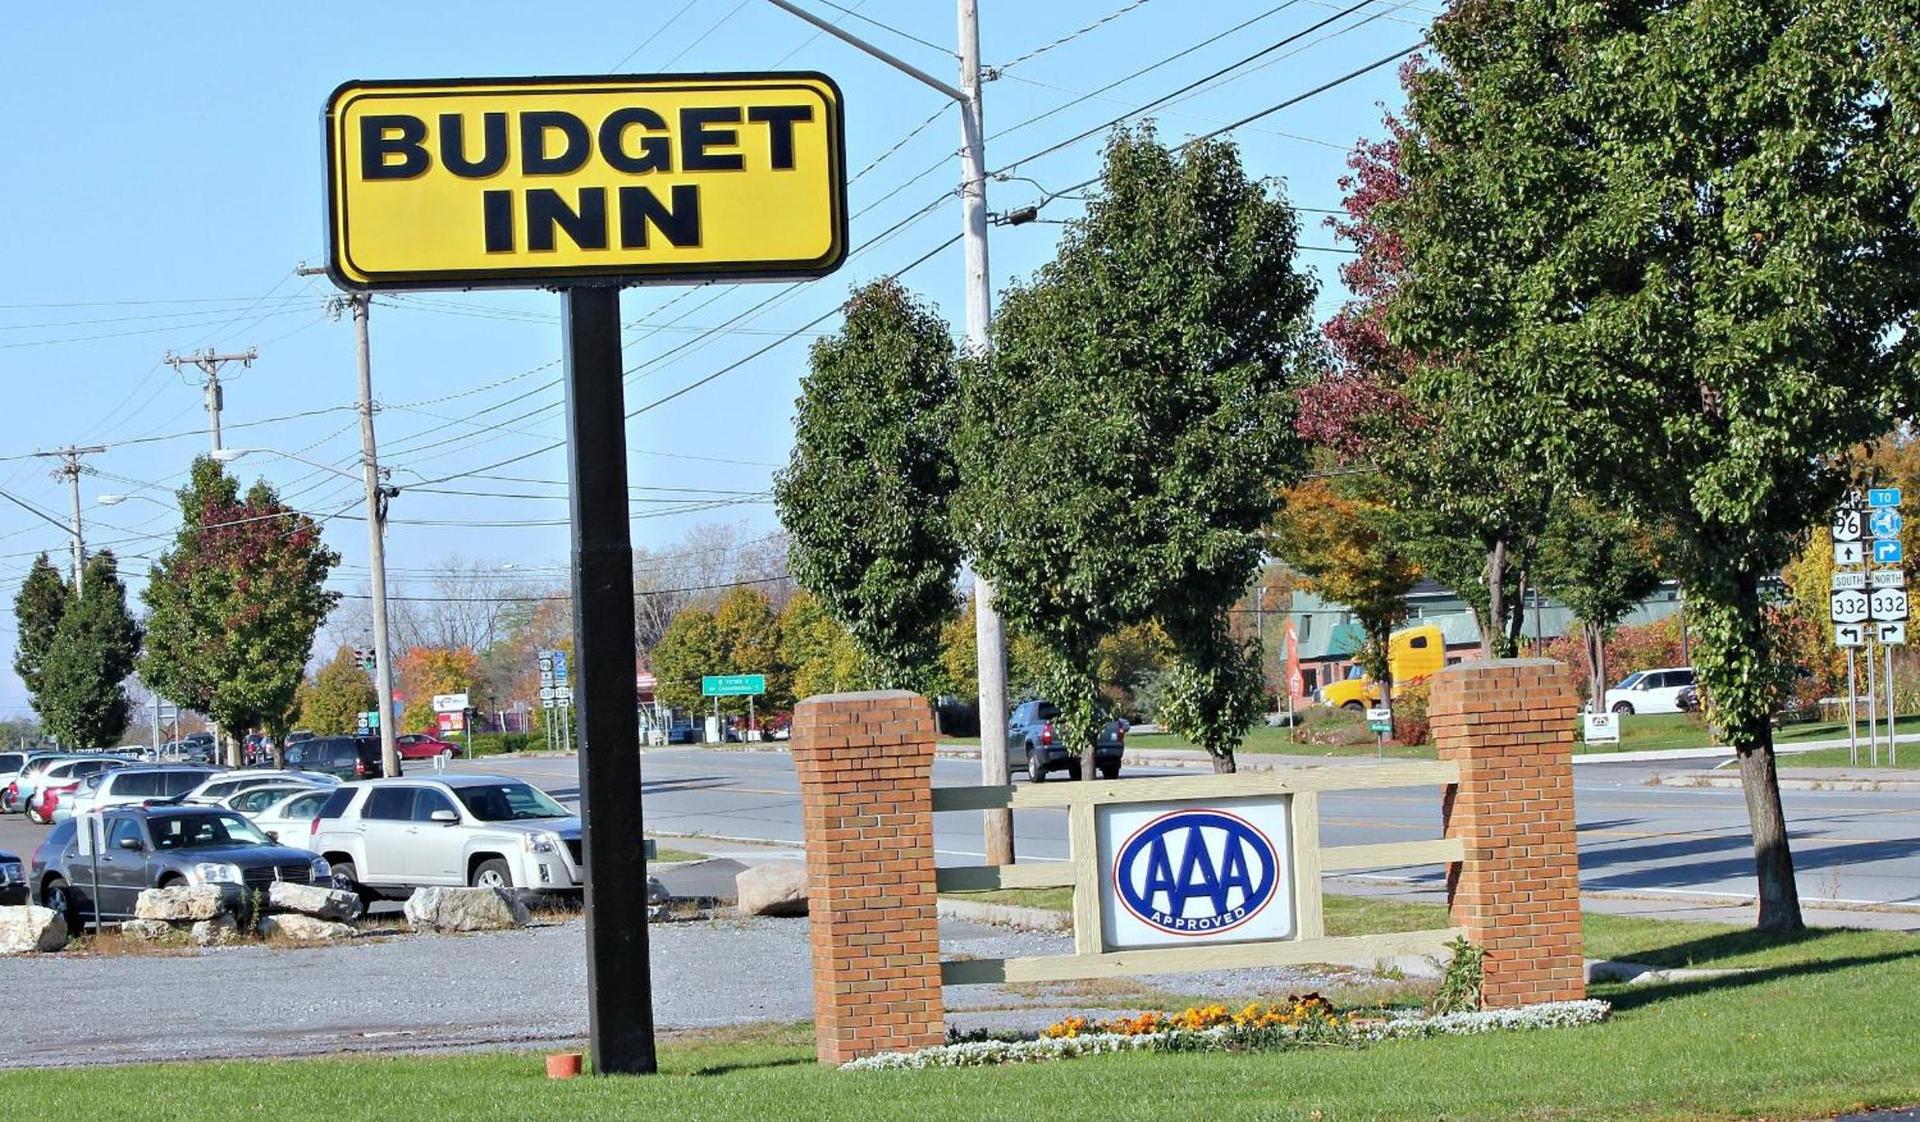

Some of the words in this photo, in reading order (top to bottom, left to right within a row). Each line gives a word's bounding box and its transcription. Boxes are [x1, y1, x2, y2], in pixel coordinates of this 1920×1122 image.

[360, 104, 815, 181] BUDGET
[482, 184, 702, 254] INN
[1877, 492, 1892, 503] TO
[1837, 517, 1859, 534] 96
[1836, 575, 1863, 587] SOUTH
[1874, 573, 1902, 585] NORTH
[1834, 598, 1866, 615] 332
[1874, 596, 1905, 613] 332
[1143, 825, 1254, 920] AAA
[1151, 906, 1246, 931] APPROVED
